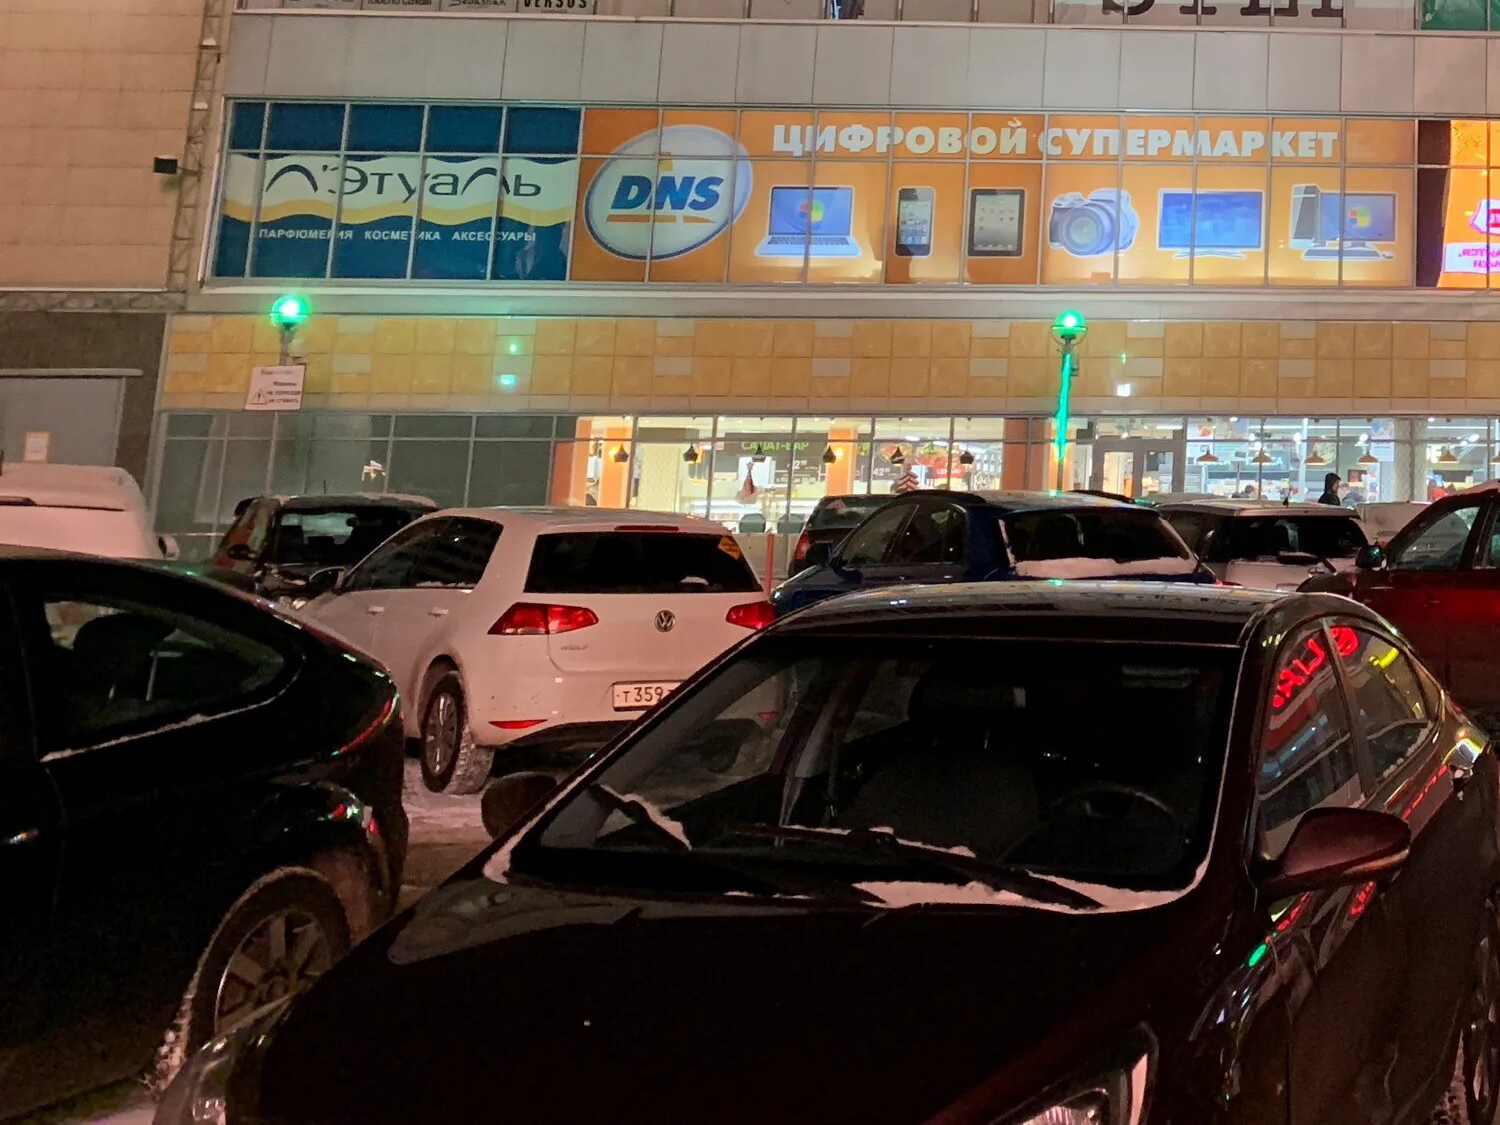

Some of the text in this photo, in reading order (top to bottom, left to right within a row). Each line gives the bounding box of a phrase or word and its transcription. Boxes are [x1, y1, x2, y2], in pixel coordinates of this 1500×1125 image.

[772, 117, 1027, 157] ЦИФРОВОЙ
[611, 175, 724, 210] DNS
[622, 686, 673, 703] Т359
